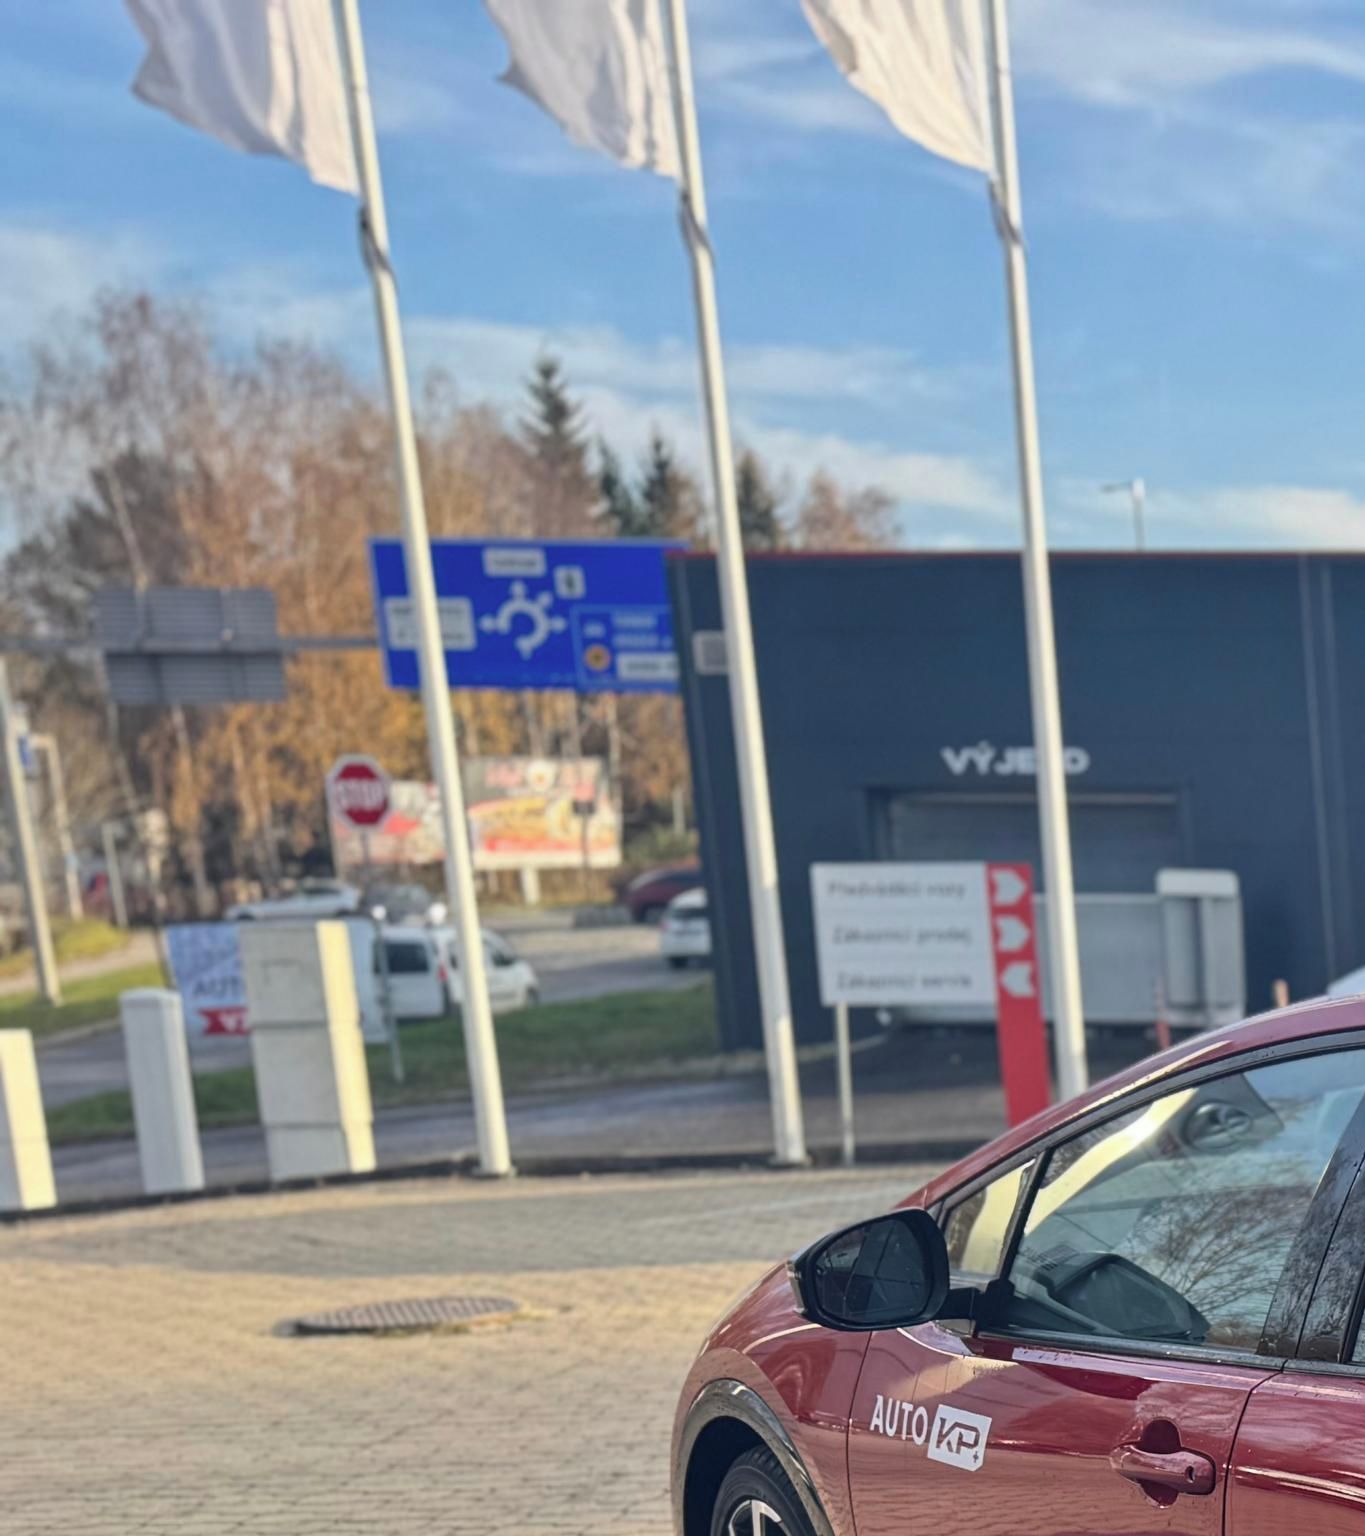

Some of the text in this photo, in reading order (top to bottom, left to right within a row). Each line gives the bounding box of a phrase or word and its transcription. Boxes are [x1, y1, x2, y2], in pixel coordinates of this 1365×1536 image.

[940, 741, 1090, 775] VÝJED
[337, 780, 384, 809] STOP
[869, 1394, 928, 1446] AUTO
